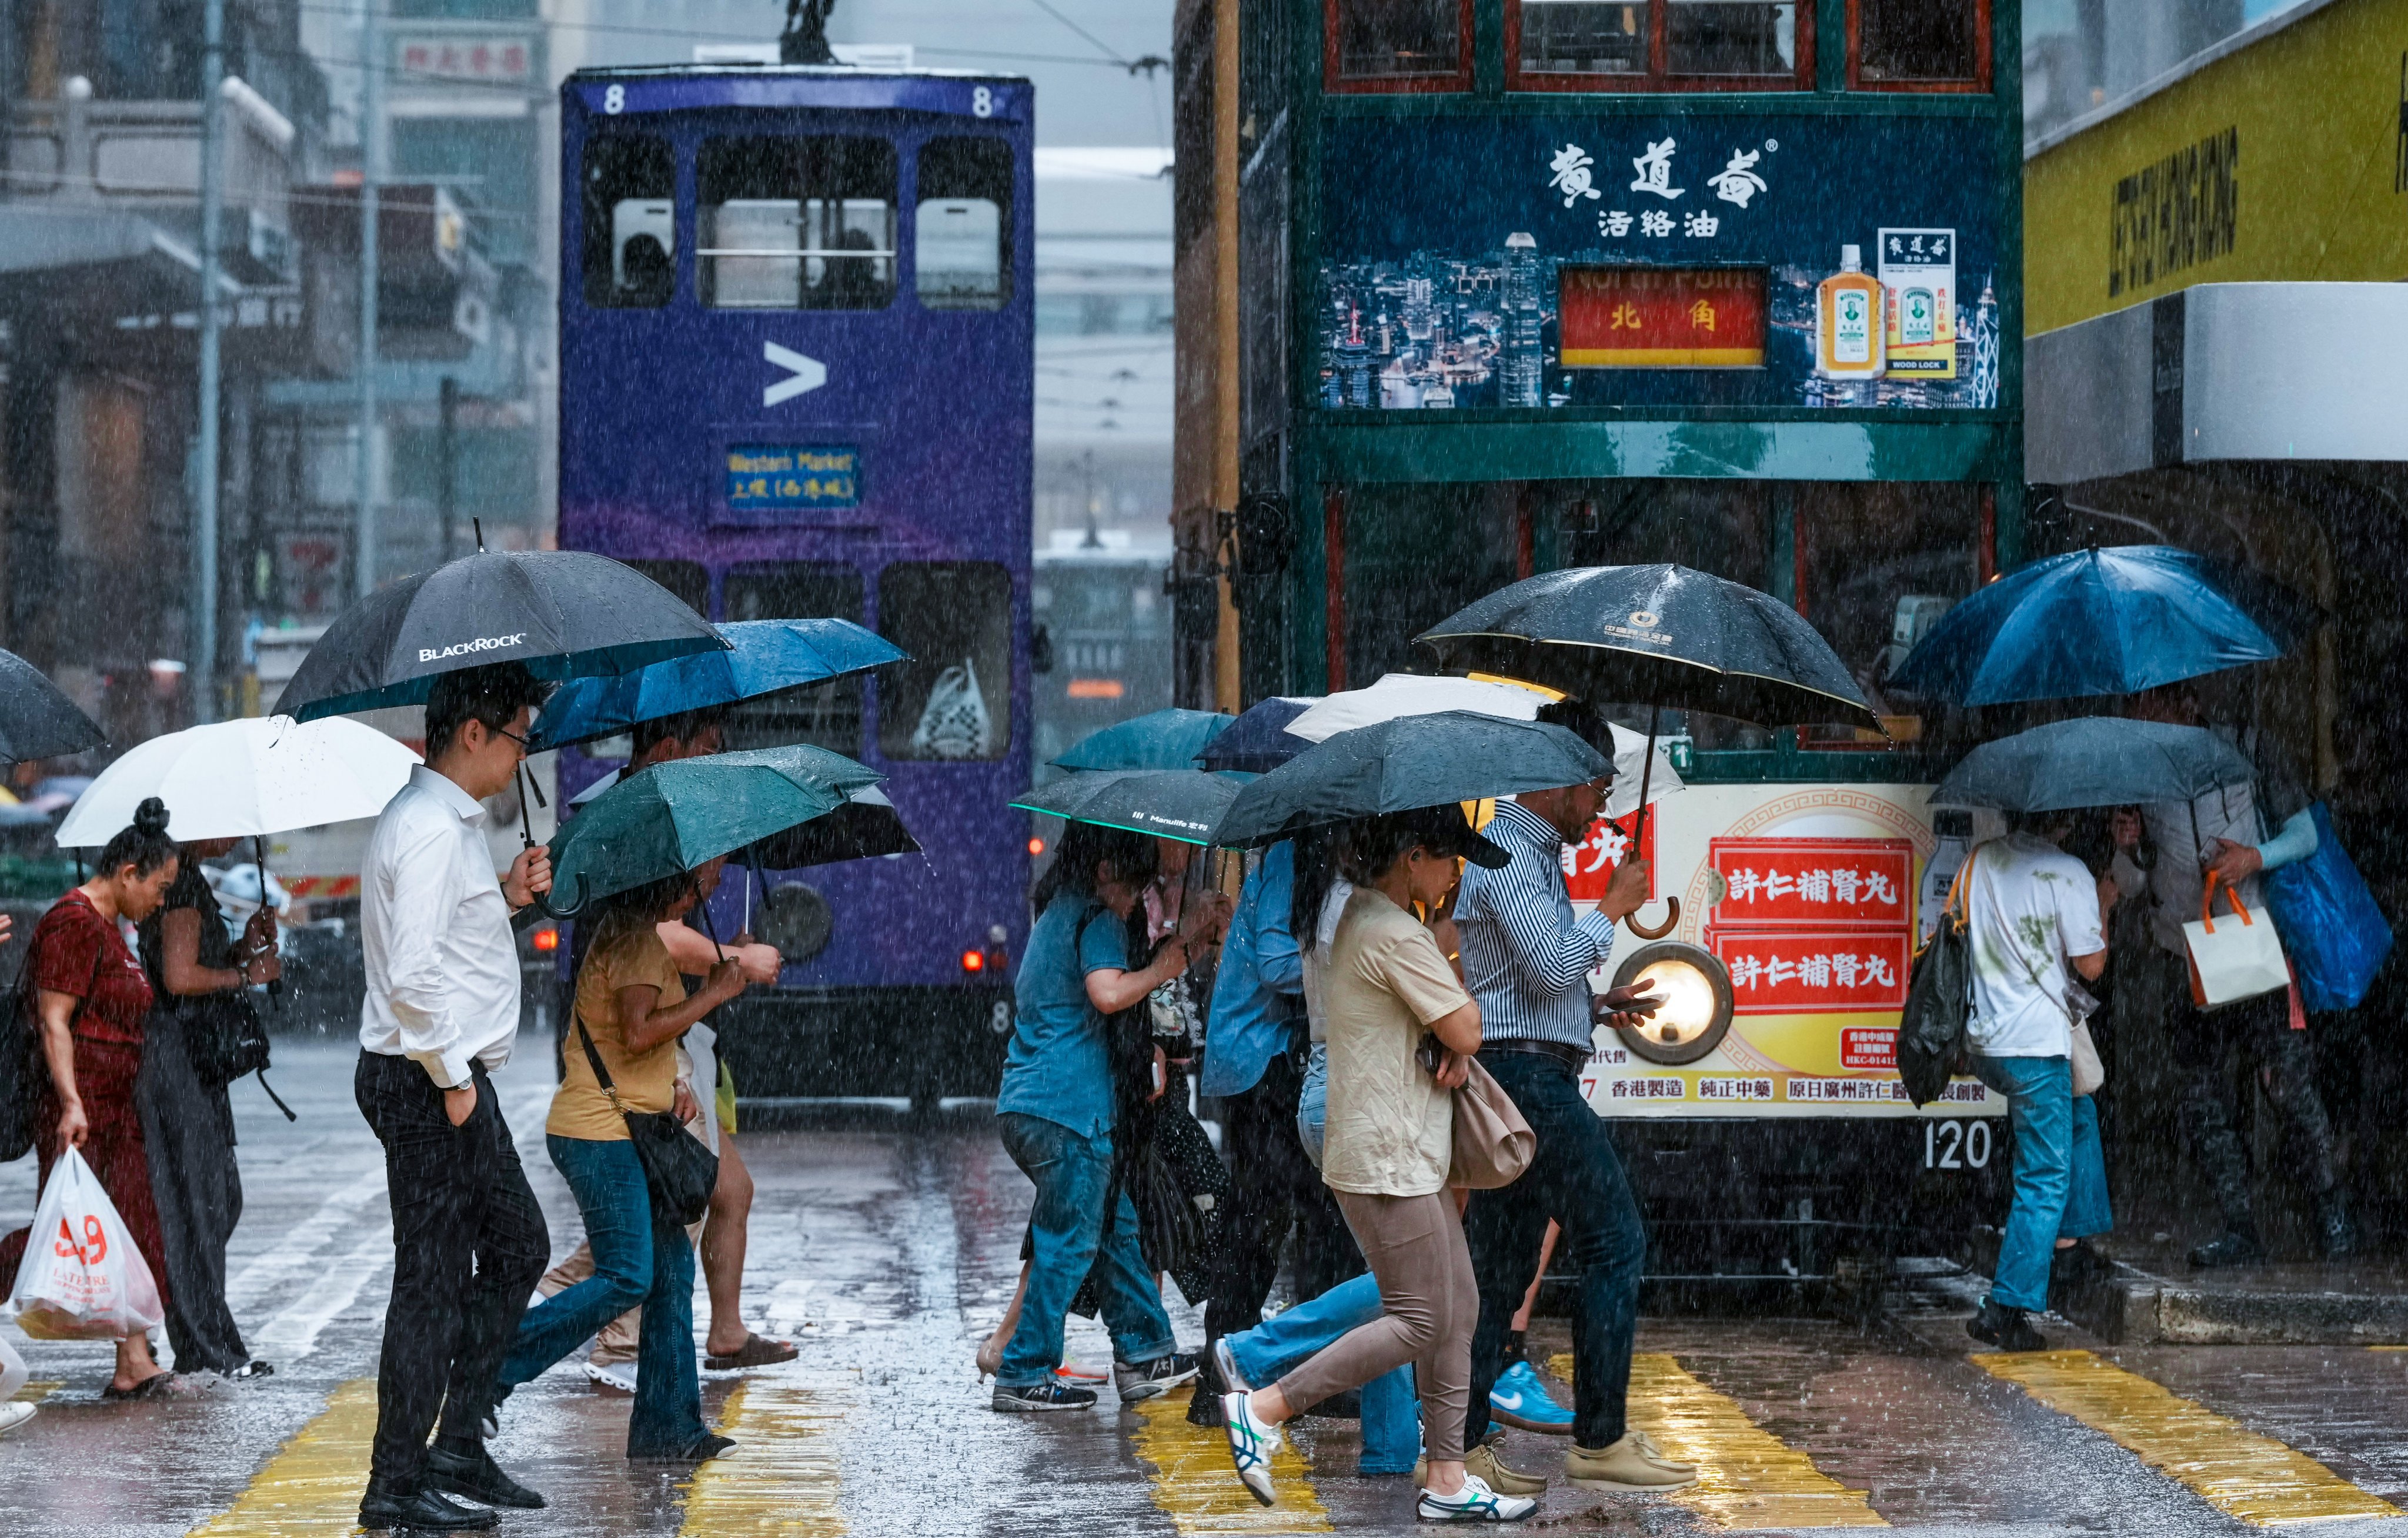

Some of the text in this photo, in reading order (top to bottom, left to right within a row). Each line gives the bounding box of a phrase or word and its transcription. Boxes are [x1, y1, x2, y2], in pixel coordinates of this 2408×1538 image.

[604, 84, 624, 115] 8
[973, 86, 992, 118] 8
[1598, 209, 1718, 238] 活絡油
[1610, 299, 1715, 332] 北角
[1150, 815, 1187, 827] Manulife
[1188, 822, 1208, 831] 宏利
[1728, 867, 1898, 905] 許仁補腎丸
[1730, 952, 1896, 991] 許仁補腎丸
[992, 1001, 1010, 1034] 8
[1611, 1079, 1684, 1098] 香港製造
[1699, 1079, 1771, 1098] 純正中藥
[1925, 1119, 1992, 1169] 120
